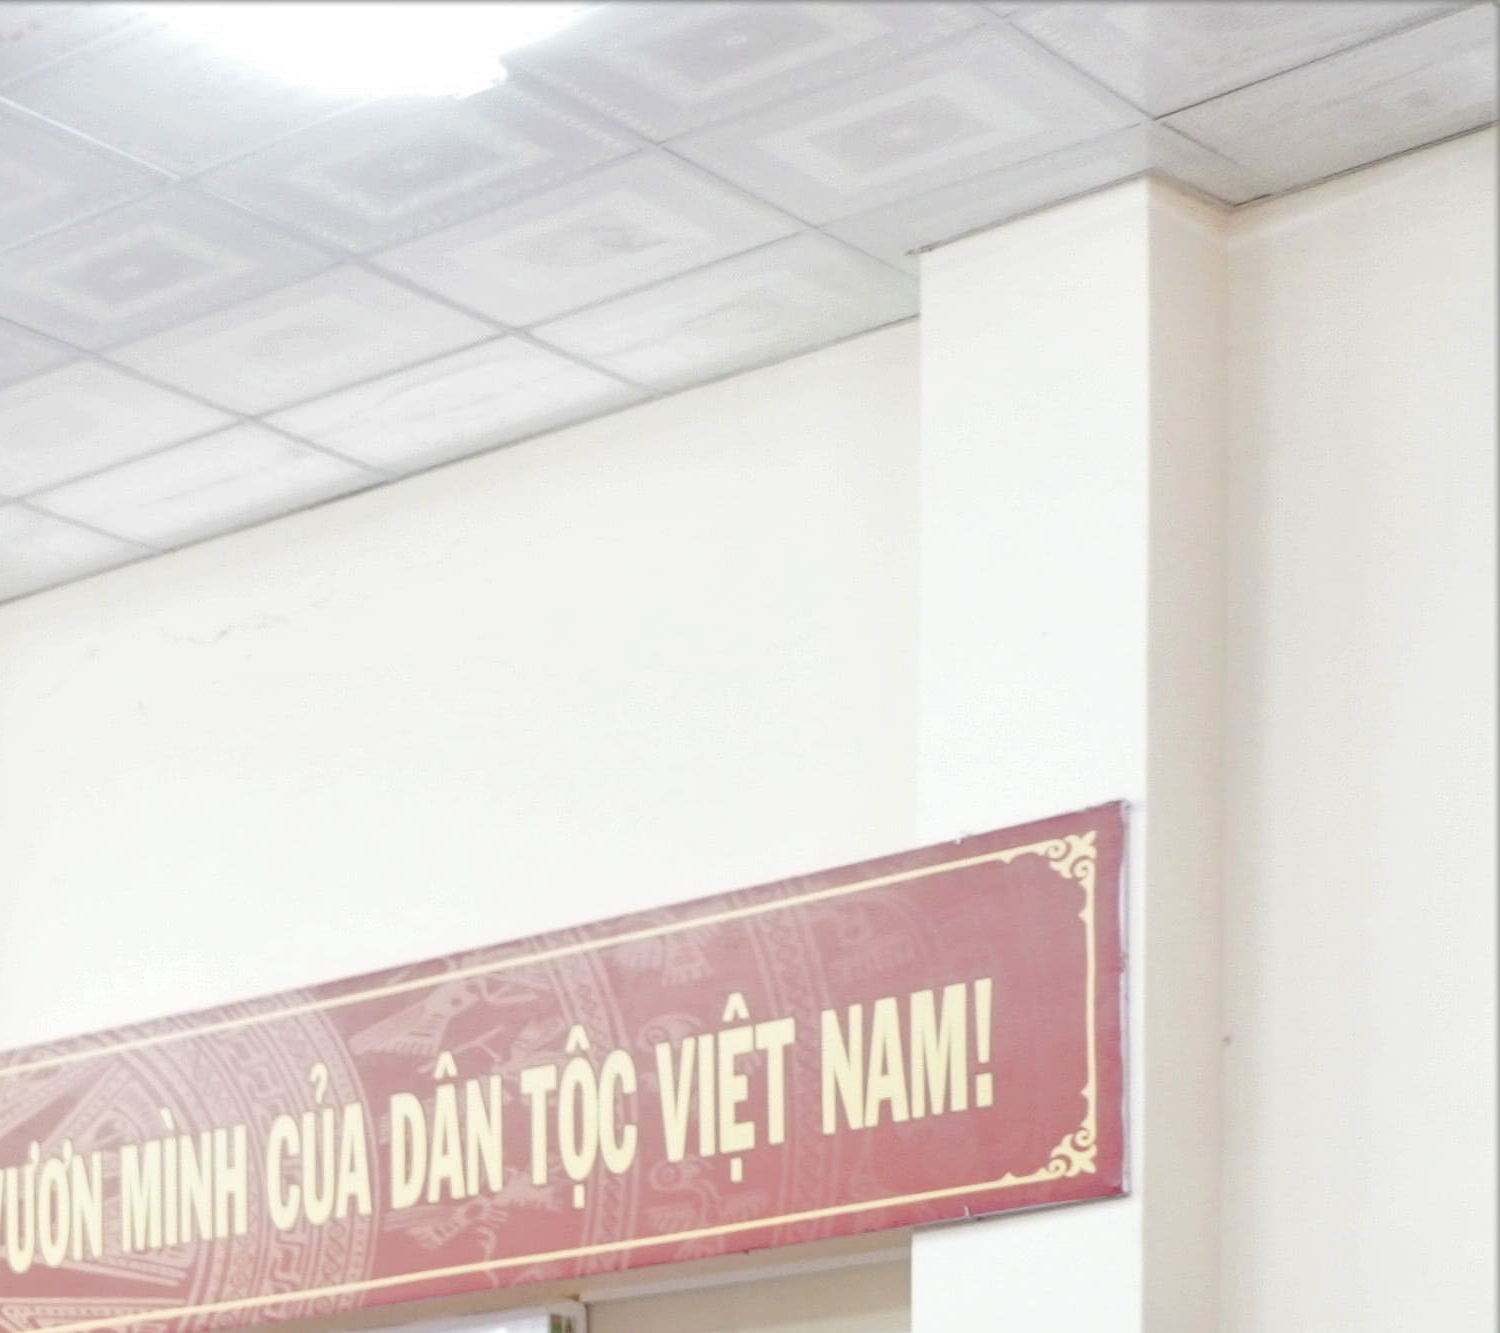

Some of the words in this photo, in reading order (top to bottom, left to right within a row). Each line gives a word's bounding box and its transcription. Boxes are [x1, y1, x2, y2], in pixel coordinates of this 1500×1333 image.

[120, 1106, 248, 1254] MÌNH
[267, 1062, 372, 1232] CỦA
[390, 1050, 503, 1210] DÂN
[520, 1023, 638, 1209] TỘC
[655, 992, 796, 1183] VIỆT
[820, 977, 994, 1136] NAM!
